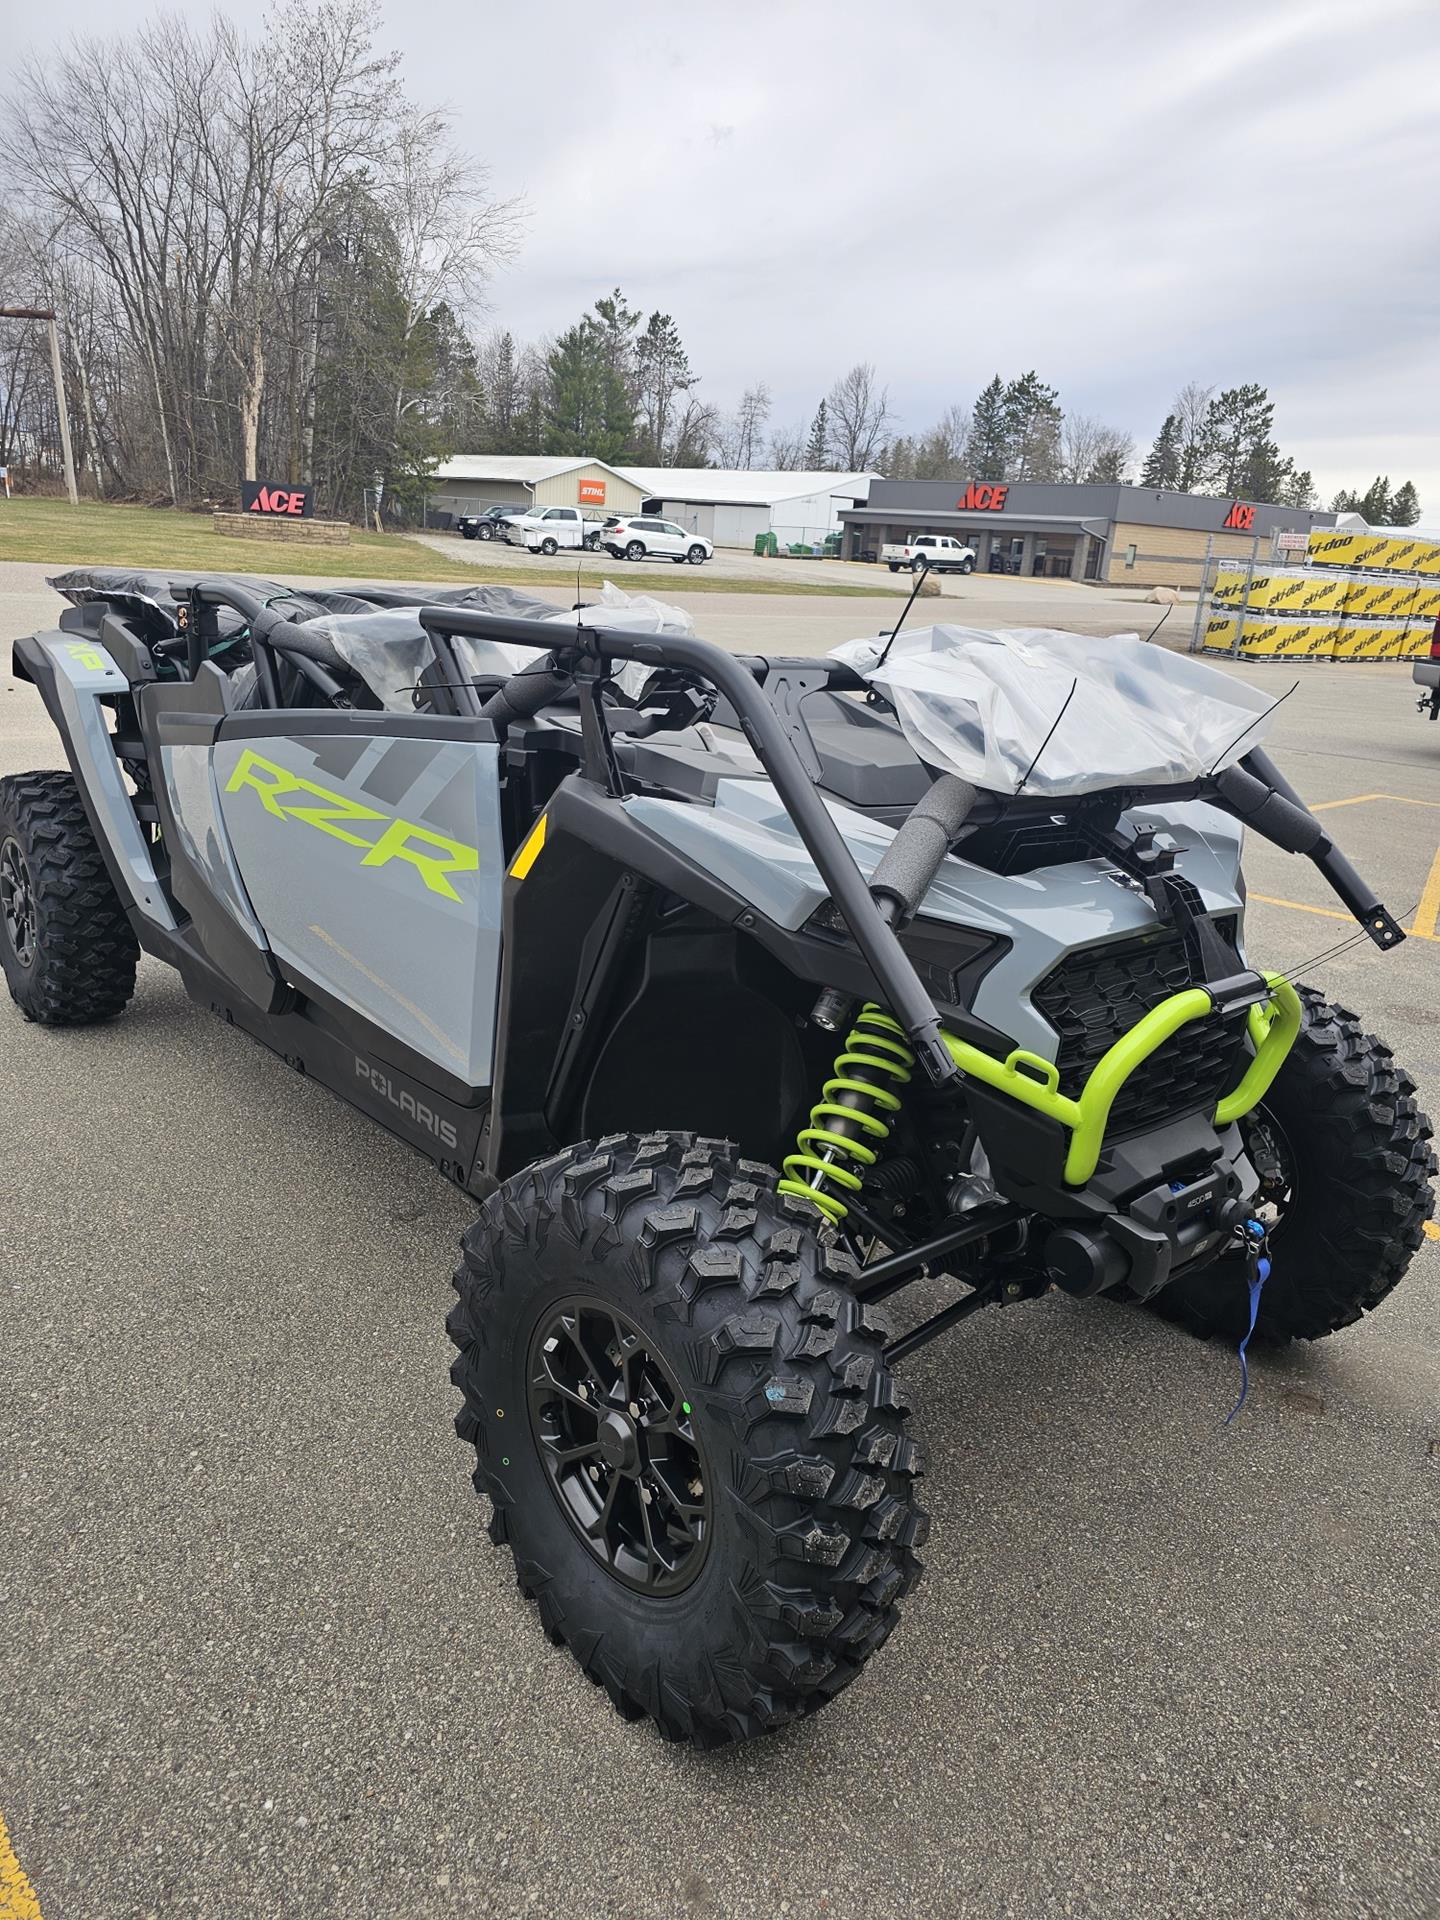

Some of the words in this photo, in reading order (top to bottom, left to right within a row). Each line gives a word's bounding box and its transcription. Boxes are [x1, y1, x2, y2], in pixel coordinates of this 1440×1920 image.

[249, 486, 304, 514] ACE
[580, 486, 605, 497] STIHL
[957, 481, 1008, 510] ACE
[1223, 501, 1257, 529] ACE
[1307, 535, 1354, 556] ki-doo
[1268, 580, 1305, 607] ski-doo
[1301, 582, 1338, 608] ski-doo
[1274, 626, 1311, 653] ski-doo
[64, 642, 104, 670] XP
[224, 749, 479, 904] RZR
[354, 1056, 458, 1149] POLARIS
